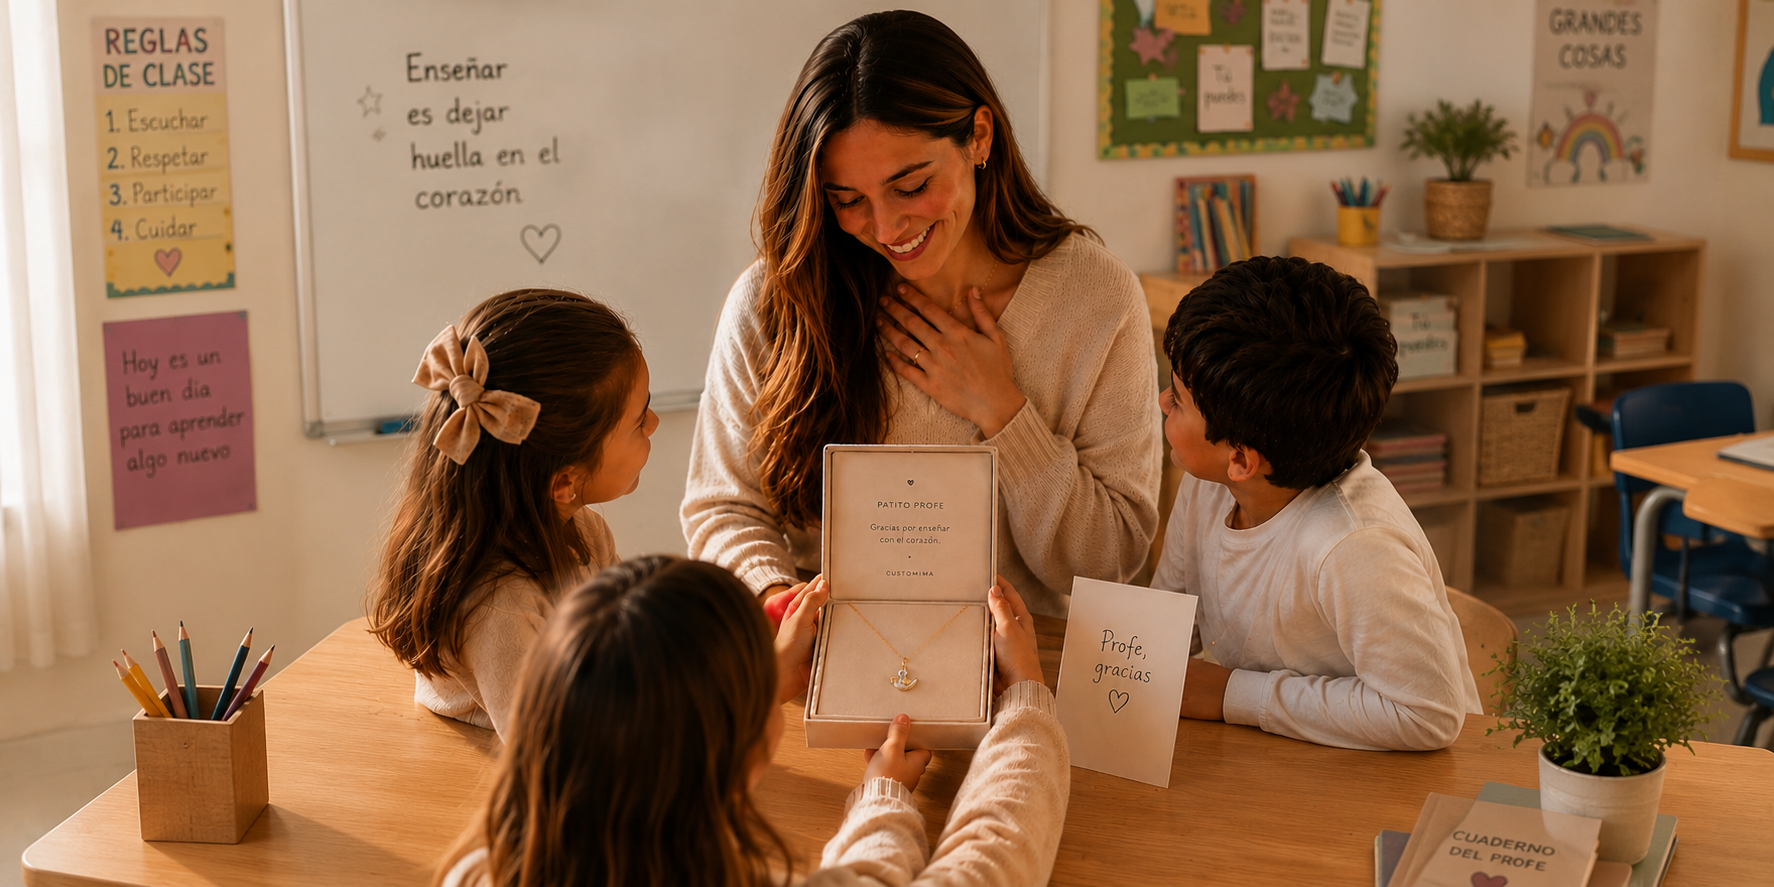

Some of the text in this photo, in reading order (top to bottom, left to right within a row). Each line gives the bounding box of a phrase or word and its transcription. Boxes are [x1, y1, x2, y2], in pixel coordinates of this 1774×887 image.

[1549, 8, 1643, 36] GRANDES
[104, 27, 209, 55] REGLAS
[406, 51, 508, 83] Enseñar
[1558, 43, 1628, 70] COSAS
[103, 61, 216, 88] DE CLASE
[105, 107, 209, 133] 1. Escuchar
[407, 97, 511, 136] es dejar
[106, 144, 209, 175] 2. Respetar
[411, 135, 561, 171] huella en el
[108, 181, 218, 208] 3. Participar
[414, 180, 524, 210] corazón
[110, 215, 198, 242] 4. Cuidar
[122, 349, 222, 381] Hoy es un
[125, 384, 173, 409] buen
[119, 405, 246, 449] para aprender
[126, 444, 232, 479] algo nuevo
[877, 501, 944, 510] PATITO PROFE
[870, 523, 950, 535] Gracias por enseñar
[896, 536, 904, 544] el
[906, 536, 941, 544] corazón.
[1101, 629, 1147, 660] Profe,
[1092, 663, 1151, 684] gracias
[1452, 830, 1556, 857] CUADERNO
[1448, 845, 1547, 872] DEL PROFE
